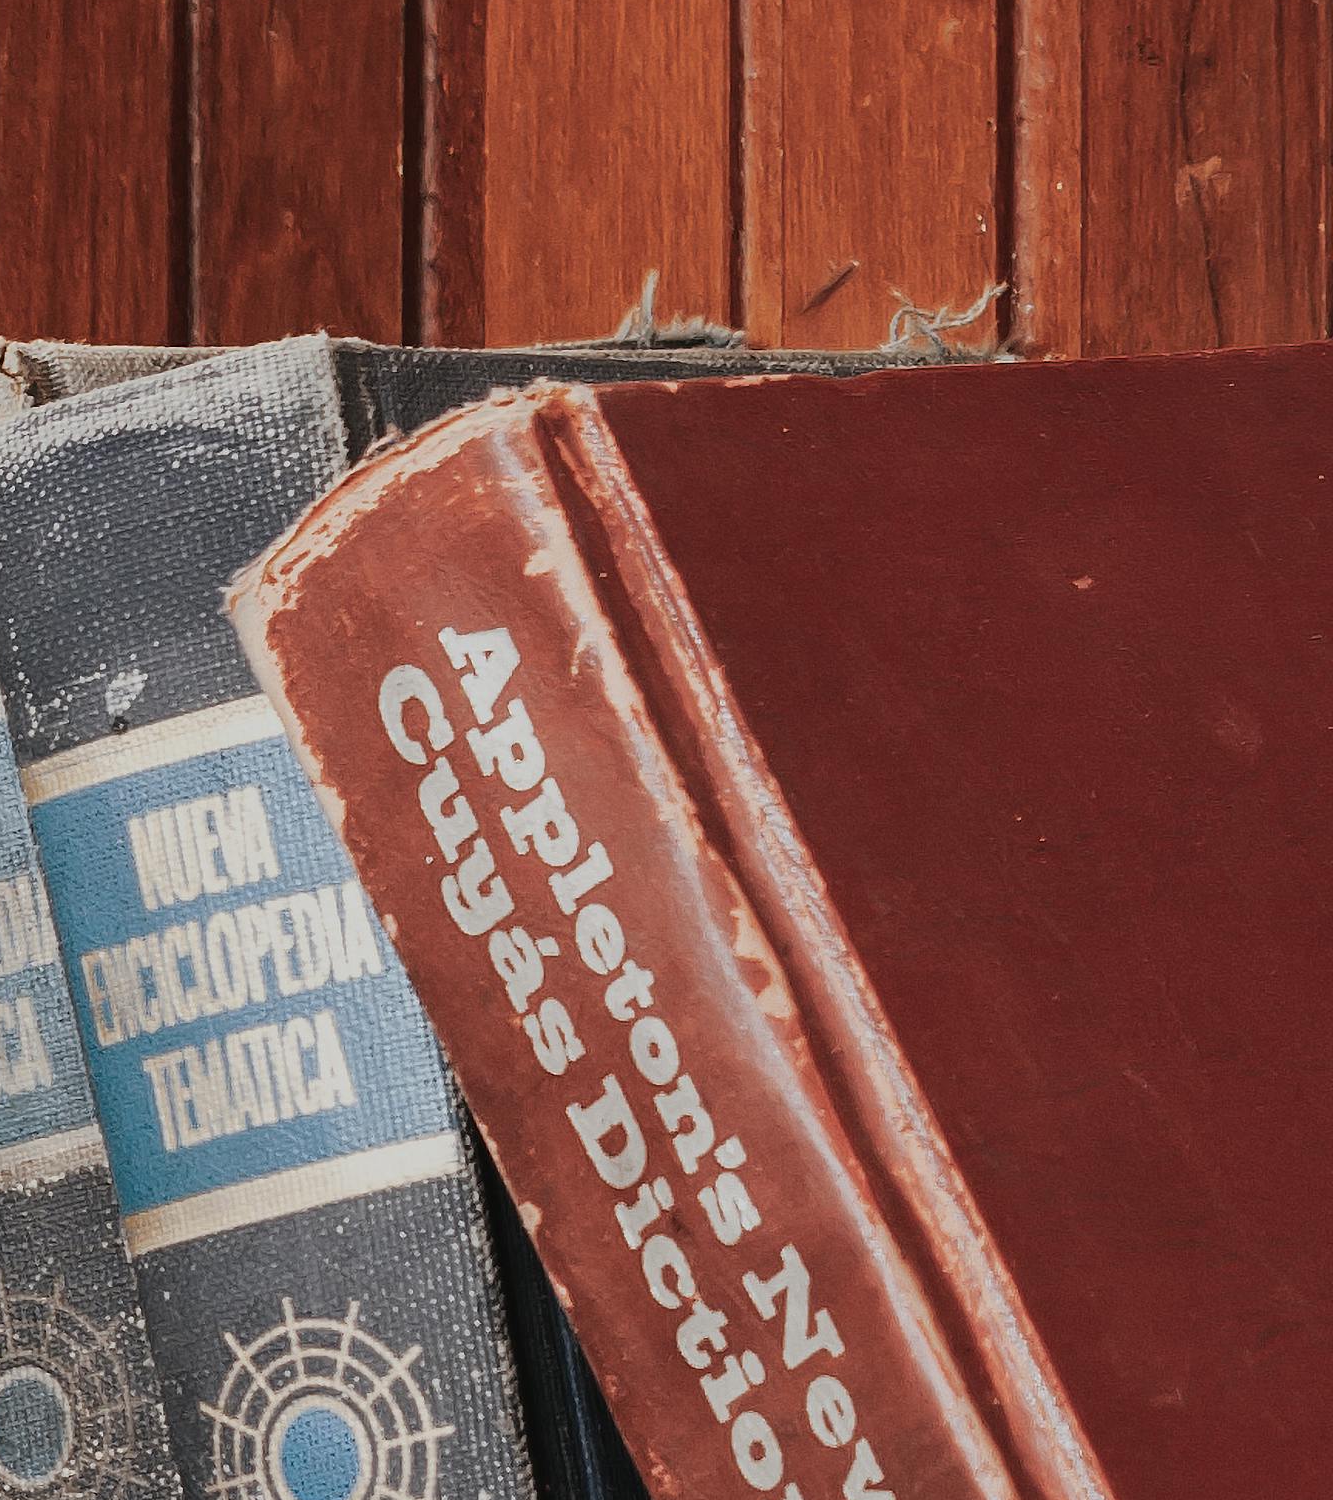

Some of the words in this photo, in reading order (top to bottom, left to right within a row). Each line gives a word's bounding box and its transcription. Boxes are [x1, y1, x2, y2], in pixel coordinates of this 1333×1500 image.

[128, 784, 280, 913] NUEVA
[378, 664, 586, 1076] Cuyás
[80, 878, 382, 1047] ENCICLOPEDIA
[438, 627, 762, 1246] Appleton's
[142, 1008, 359, 1153] TEMATICA
